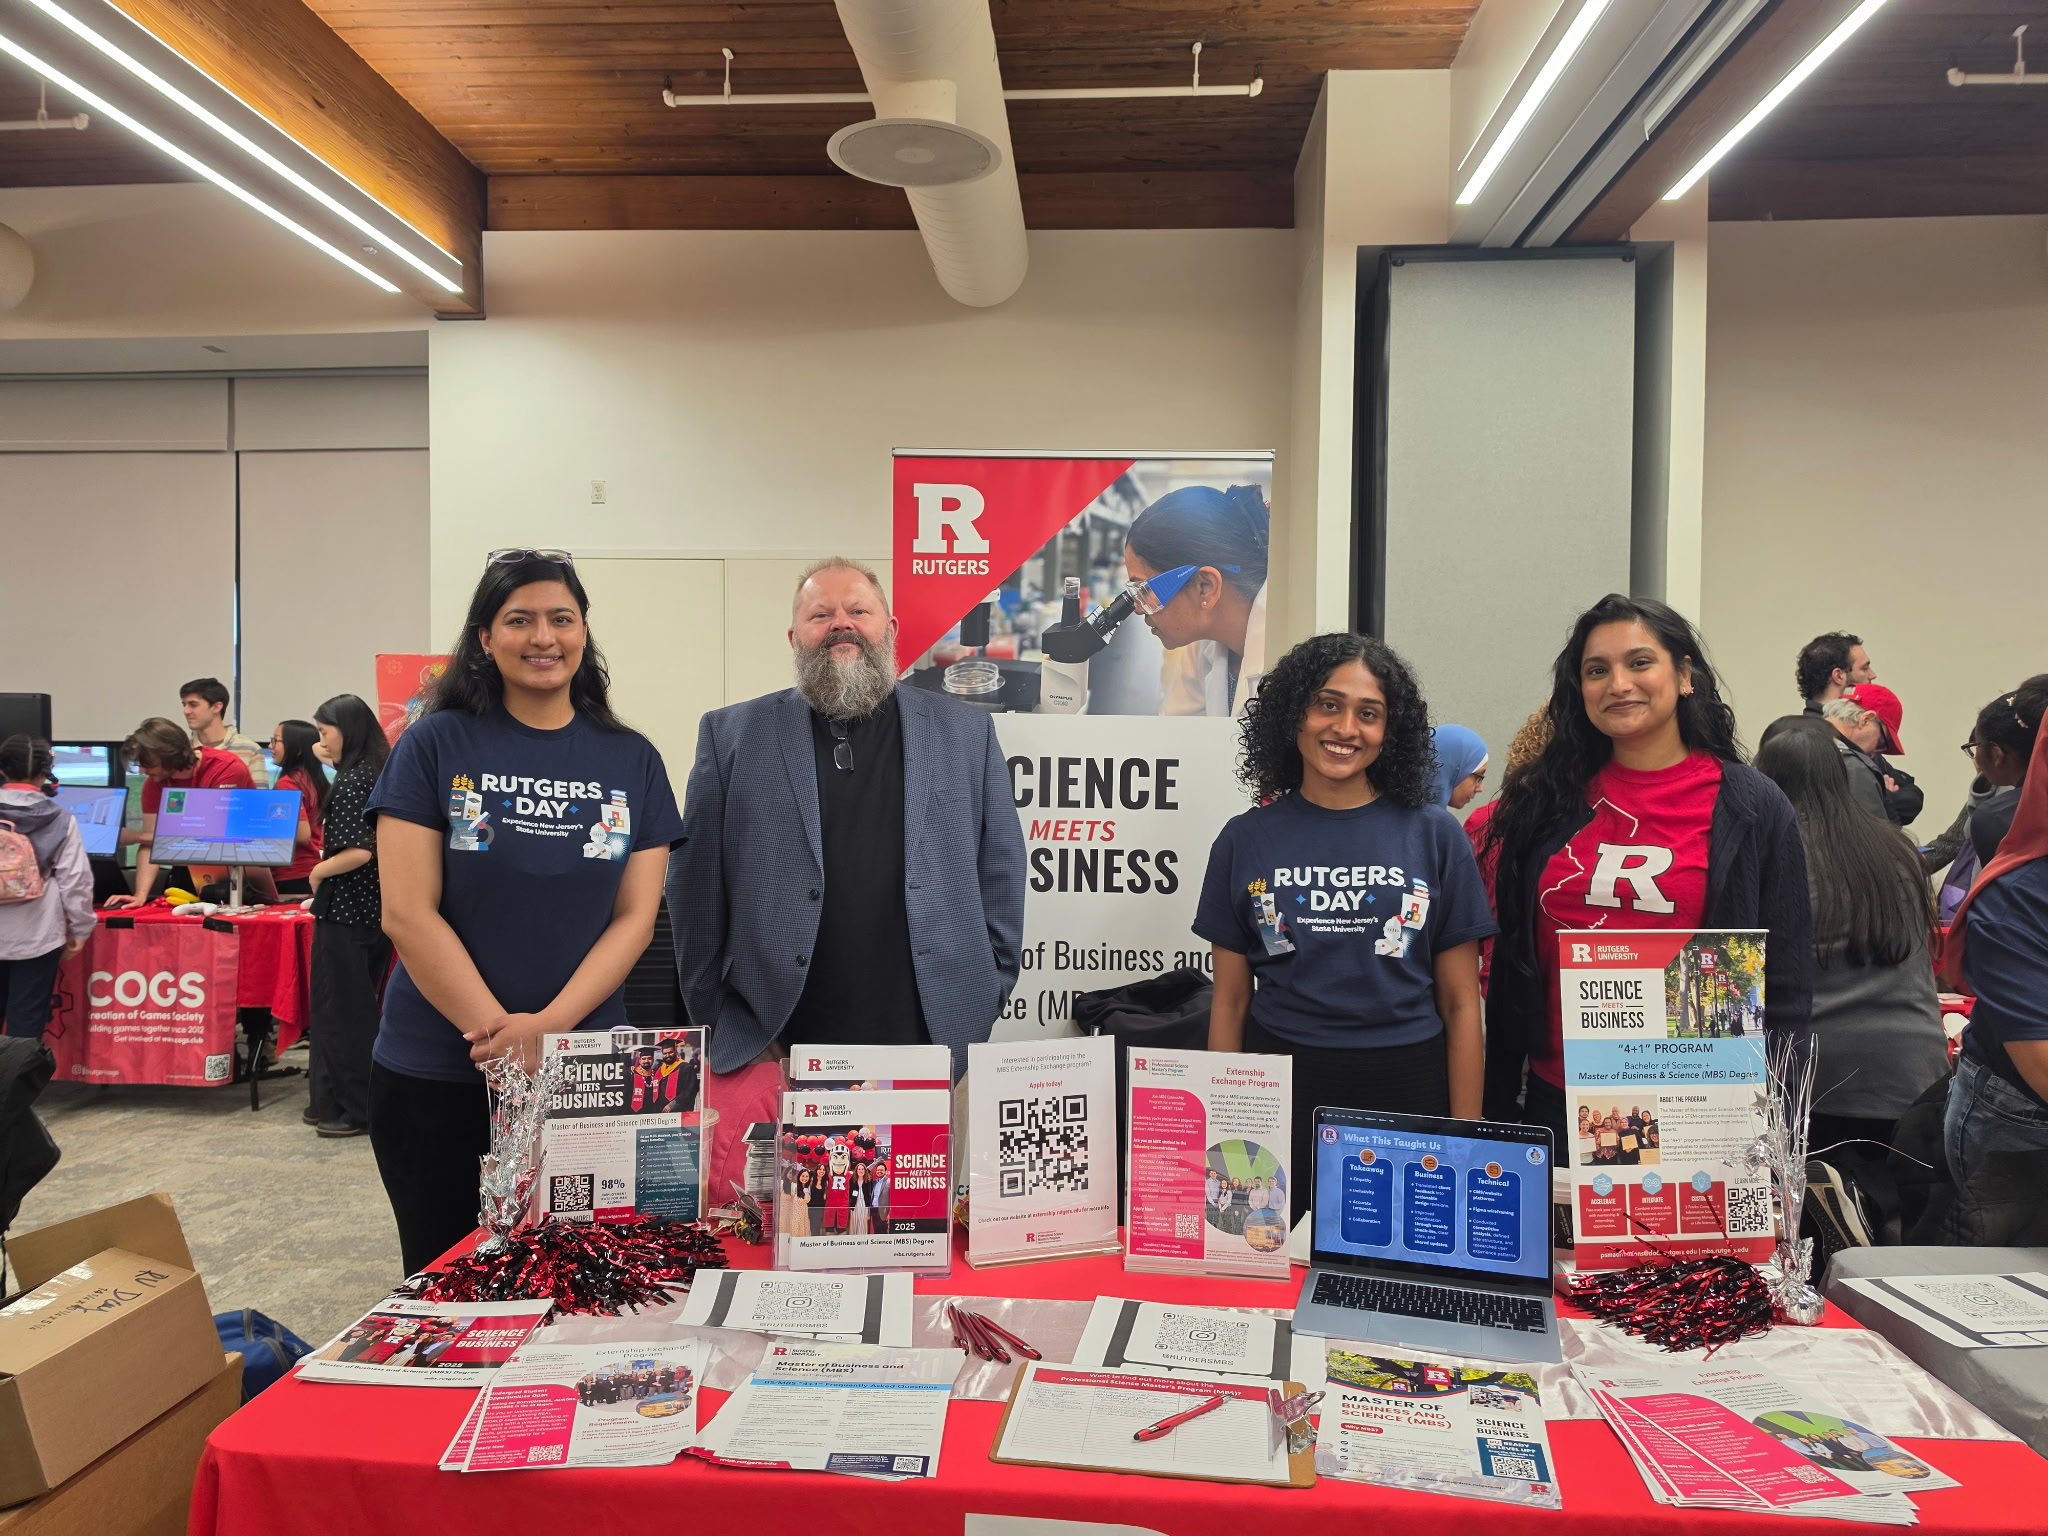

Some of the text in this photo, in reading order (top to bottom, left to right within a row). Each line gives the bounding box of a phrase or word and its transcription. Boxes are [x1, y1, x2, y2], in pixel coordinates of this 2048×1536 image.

[913, 483, 990, 554] R
[912, 559, 990, 575] RUTGERS
[482, 774, 603, 799] RUTGERS
[1006, 755, 1179, 810] CIENCE
[516, 797, 569, 818] DAY
[502, 818, 538, 828] Experience
[540, 821, 554, 829] New
[516, 826, 569, 837] State University
[1029, 820, 1116, 841] MEETS
[1030, 847, 1179, 894] SINESS
[1274, 866, 1405, 887] RUTGERS
[1584, 841, 1676, 915] R
[1310, 890, 1367, 911] DAY
[1297, 916, 1335, 925] Experience
[1353, 916, 1378, 925] Jersey's
[1021, 940, 1164, 972] of Business
[1571, 944, 1592, 962] R
[1597, 953, 1638, 961] UNIVERSITY
[87, 970, 205, 1008] COGS
[1580, 980, 1642, 1000] SCIENCE
[127, 1010, 139, 1019] of
[140, 1011, 171, 1020] Games
[172, 1012, 204, 1023] Society
[1582, 1012, 1644, 1028] BUSINESS
[1654, 1043, 1714, 1053] PROGRAM
[1002, 1056, 1029, 1064] Interested
[1037, 1054, 1069, 1062] participating
[1067, 1061, 1092, 1069] program?
[1227, 1068, 1265, 1078] Externship
[1578, 1072, 1609, 1080] Master
[1702, 1071, 1726, 1079] (MBS)
[1729, 1070, 1758, 1080] Degree
[576, 1083, 600, 1092] MEETS
[1212, 1077, 1280, 1088] Exchange Program
[552, 1091, 624, 1110] BUSINESS
[1344, 1133, 1441, 1150] What This Taught Us
[896, 1154, 946, 1168] SCIENCE
[1350, 1164, 1384, 1175] Takeaway
[1415, 1171, 1443, 1179] Business
[602, 1179, 625, 1189] 98%
[895, 1177, 946, 1189] BUSINESS
[1477, 1178, 1509, 1186] Technical
[895, 1223, 915, 1231] 2025
[800, 1240, 822, 1248] Master
[893, 1238, 911, 1246] (MBS)
[913, 1238, 934, 1246] Degree
[1702, 1247, 1748, 1255] mbs.rutges.edu
[466, 1329, 528, 1338] SCIENCE
[456, 1340, 518, 1348] BUSINESS
[1342, 1394, 1443, 1411] MASTER OF
[1342, 1403, 1445, 1420] BUSINESS AND
[1342, 1410, 1452, 1429] SCIENCE (MBS)
[1476, 1418, 1526, 1429] SCIENCE
[1477, 1428, 1529, 1438] BUSINESS
